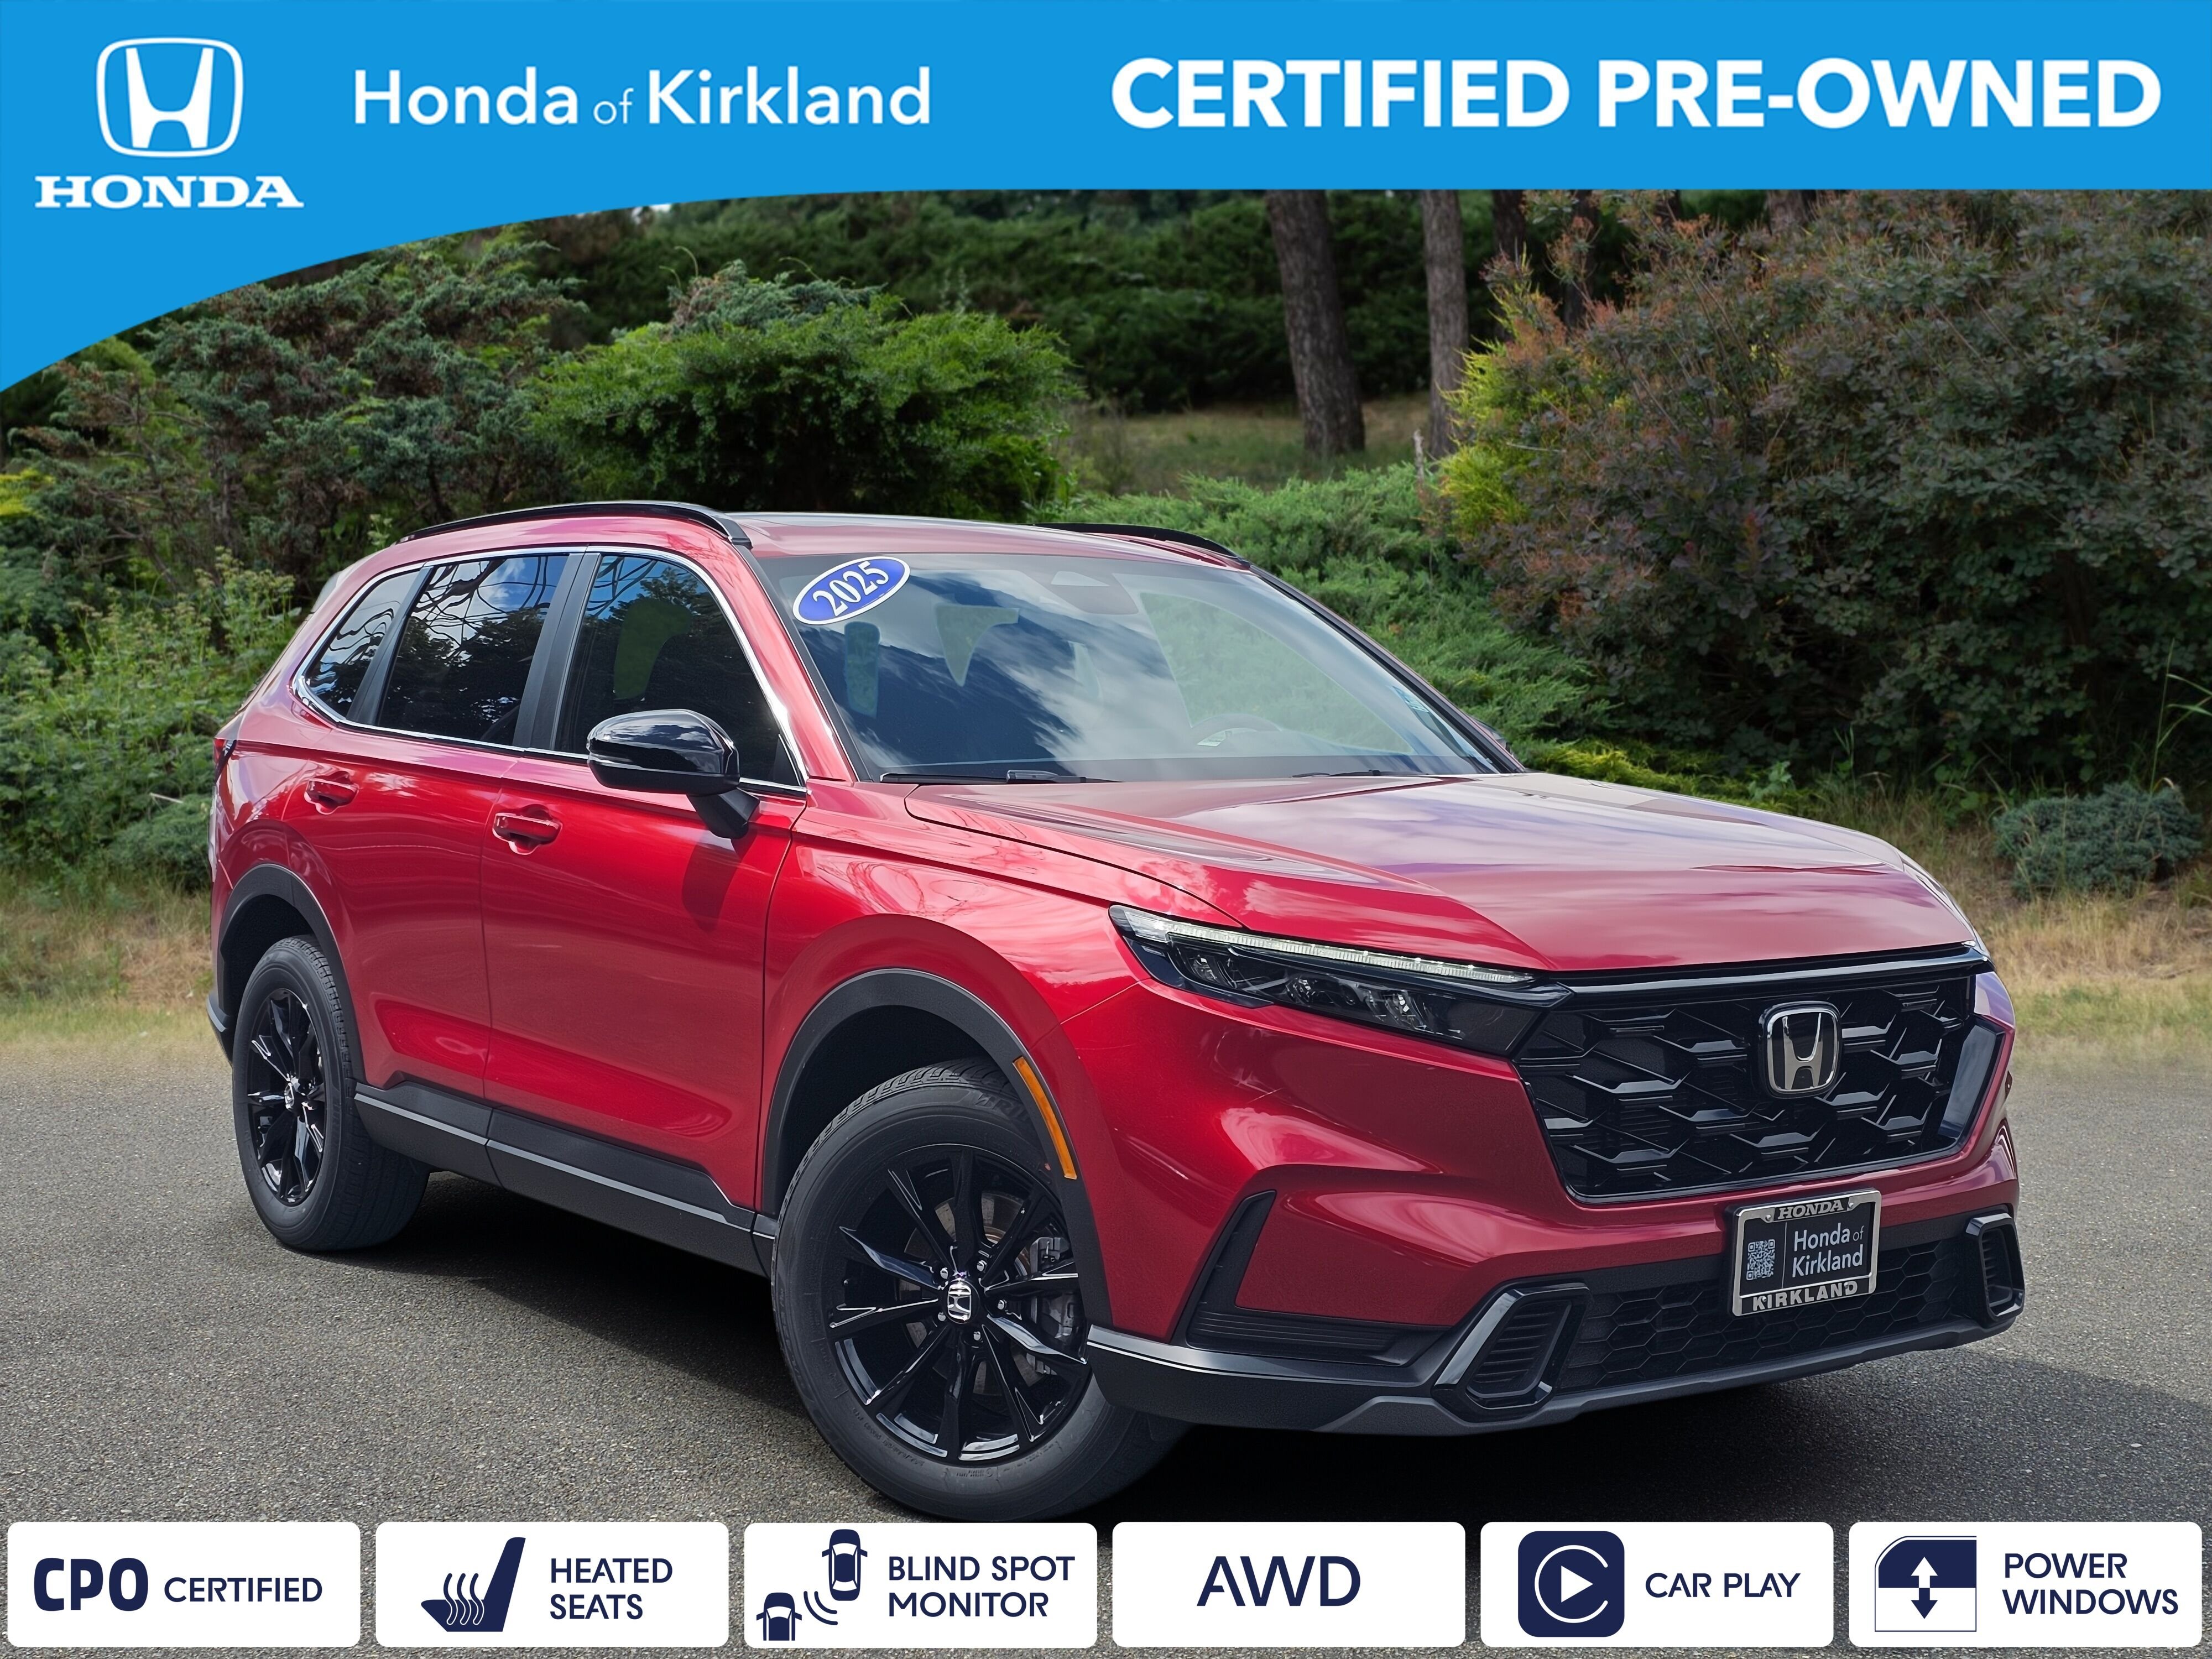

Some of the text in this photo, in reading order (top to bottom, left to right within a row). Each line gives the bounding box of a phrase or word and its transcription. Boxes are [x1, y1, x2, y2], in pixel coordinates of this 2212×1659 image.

[812, 560, 889, 617] 2025
[1777, 1198, 1844, 1220] HONDA
[1794, 1222, 1865, 1252] Honda of
[1792, 1244, 1864, 1278] Kirkland
[1752, 1280, 1858, 1312] KIRKLAND
